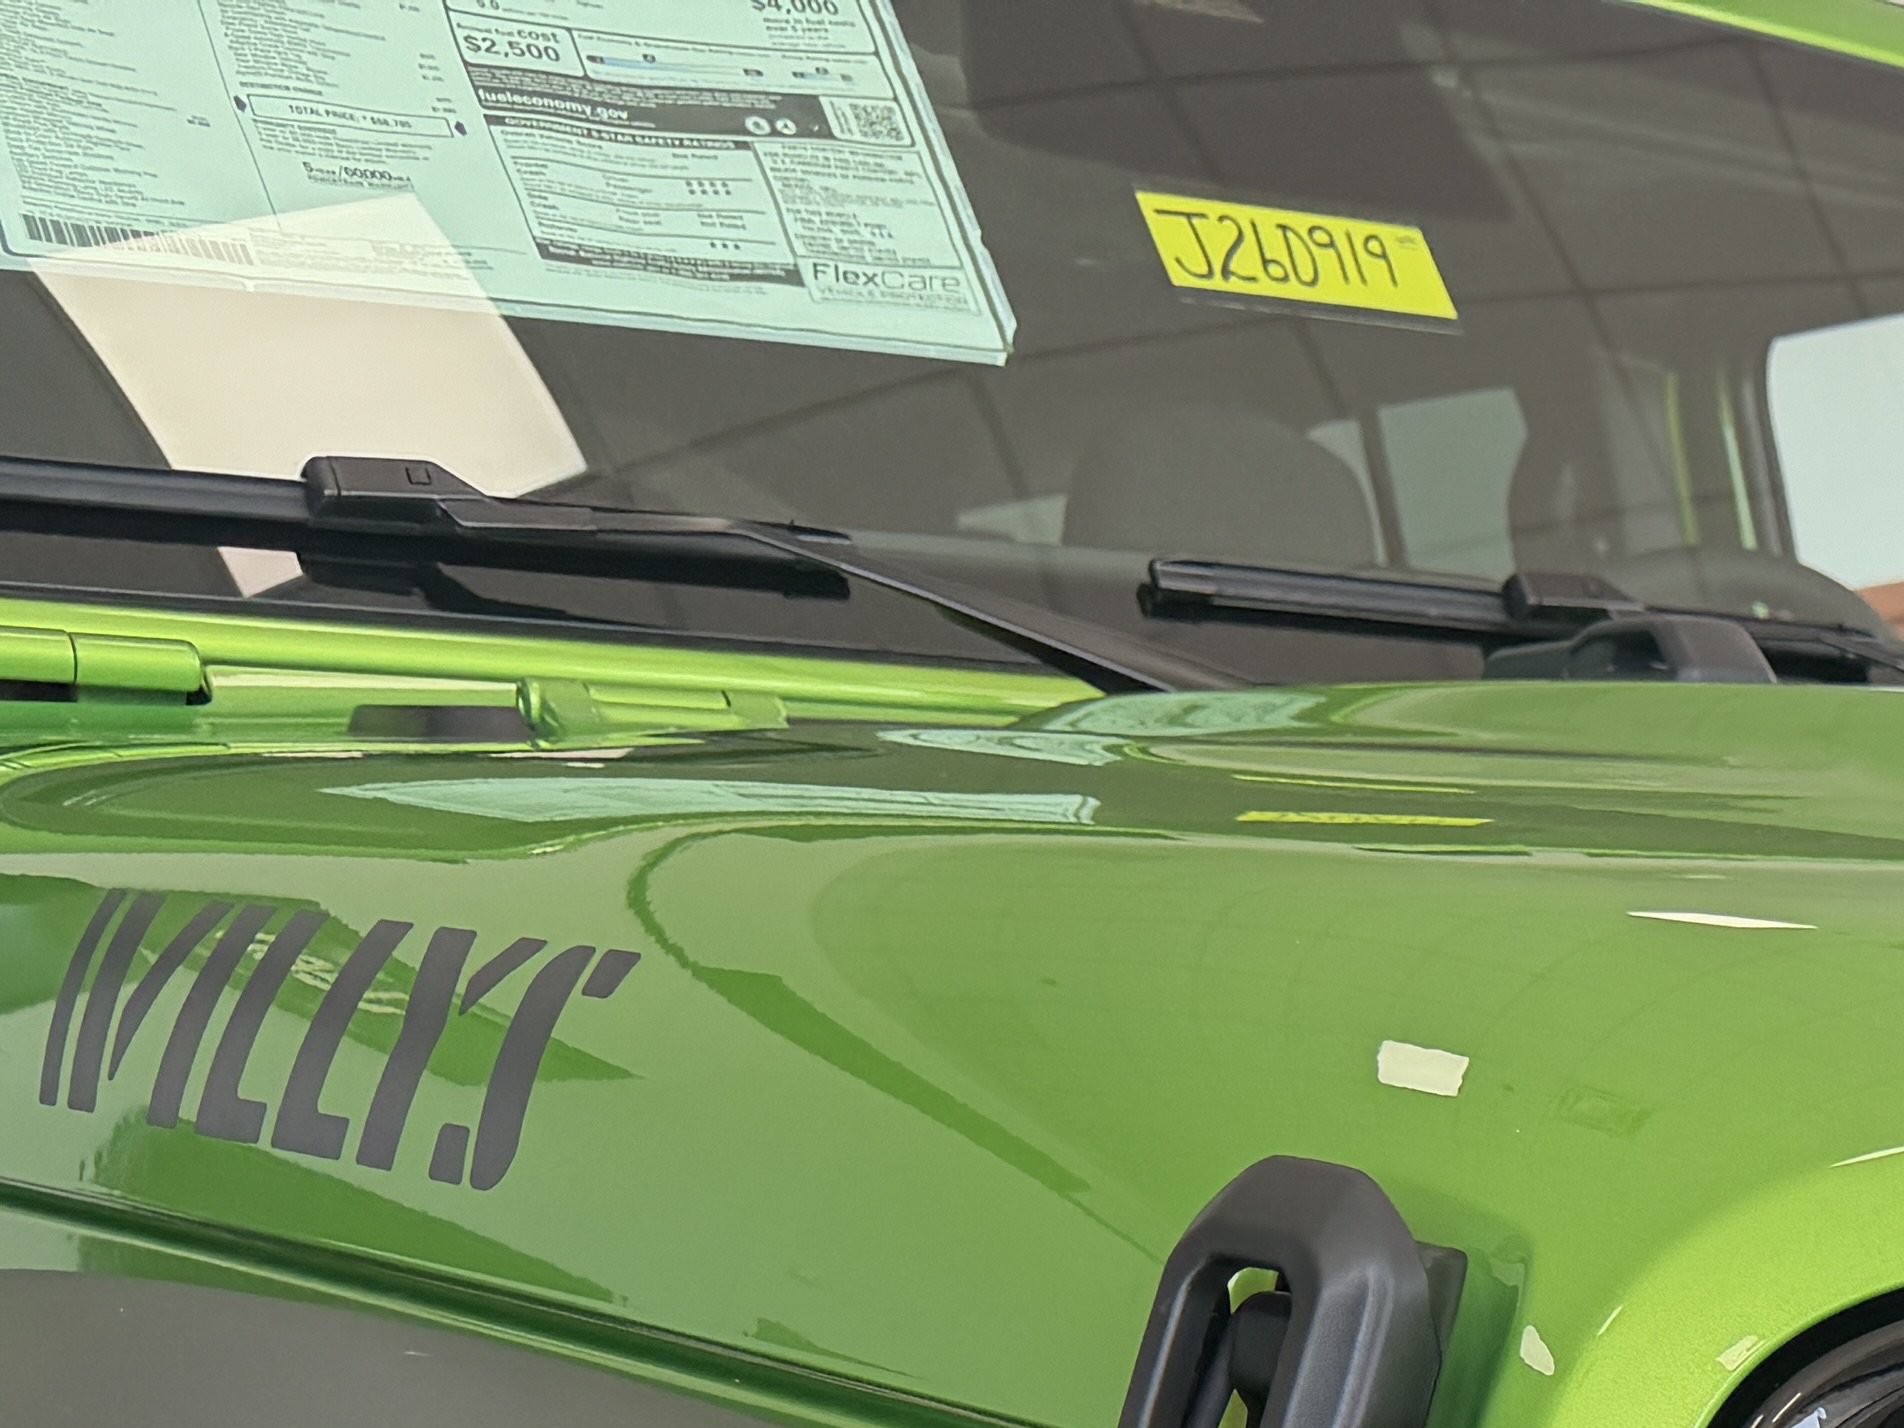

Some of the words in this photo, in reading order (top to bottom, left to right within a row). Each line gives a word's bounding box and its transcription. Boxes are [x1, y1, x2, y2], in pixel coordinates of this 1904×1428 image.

[463, 34, 561, 62] $2,500
[516, 29, 560, 44] cost
[478, 88, 629, 121] fueleconomy.gov
[812, 261, 961, 295] FlexCare
[38, 887, 642, 1191] WILLYS
